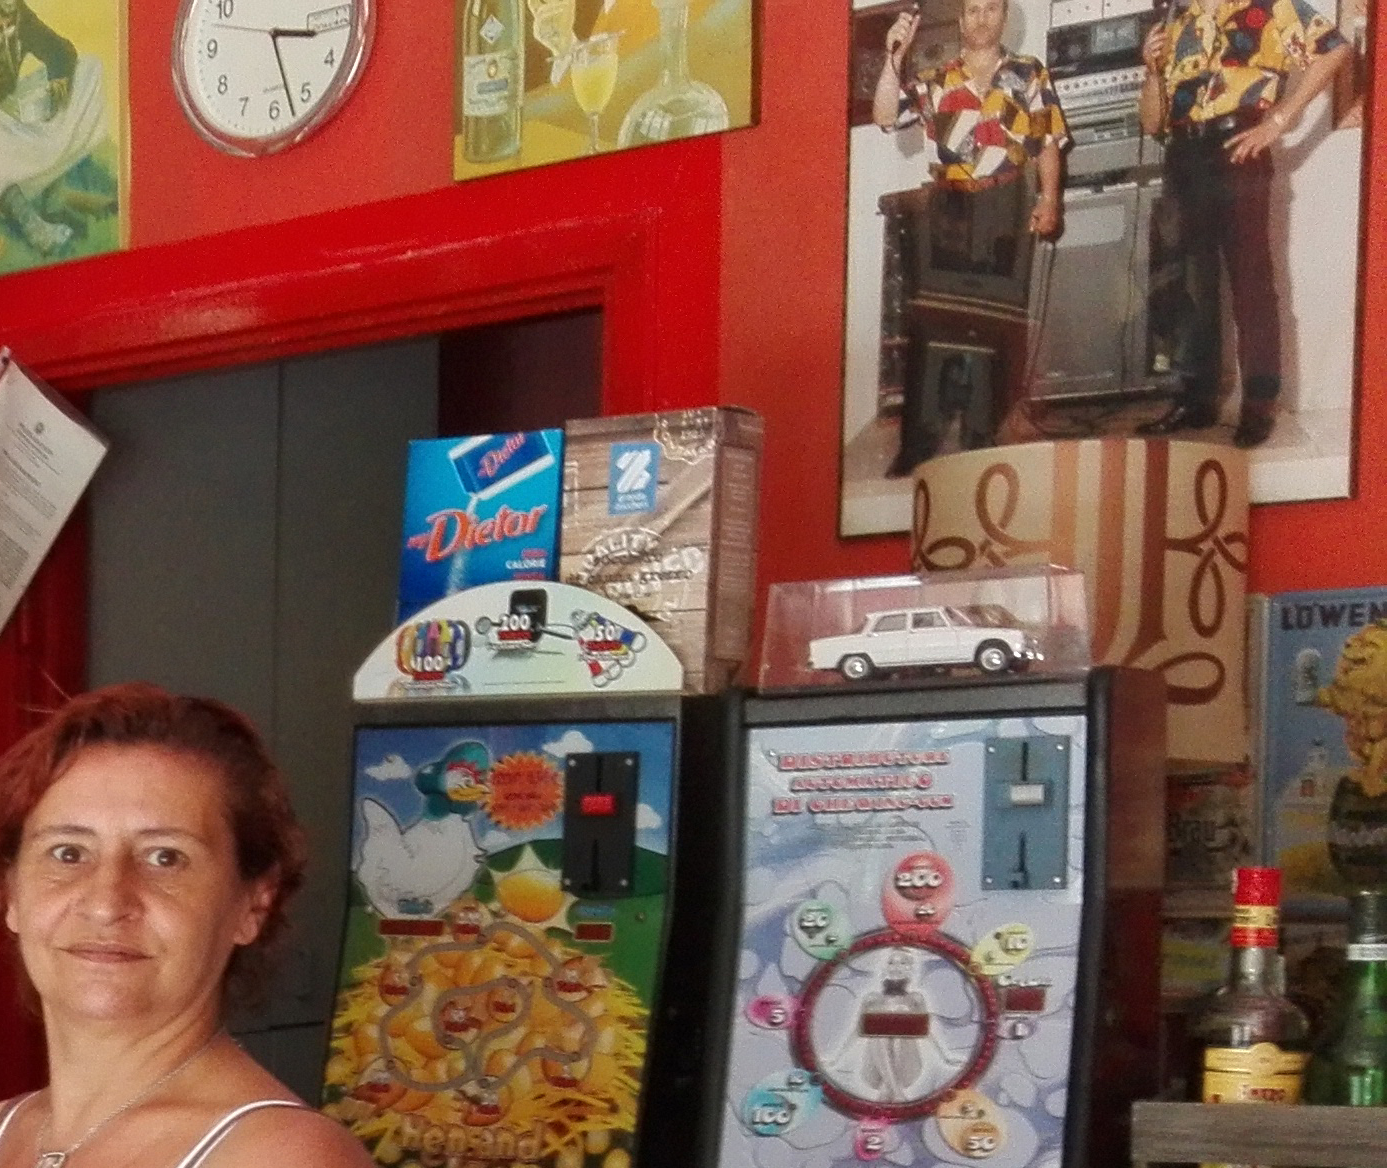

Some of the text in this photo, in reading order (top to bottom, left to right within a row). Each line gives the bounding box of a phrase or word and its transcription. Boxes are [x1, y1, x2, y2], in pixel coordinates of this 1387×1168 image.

[207, 38, 218, 59] 9
[324, 48, 335, 67] 4
[217, 74, 228, 95] 8
[300, 82, 312, 103] 5
[238, 96, 249, 116] 7
[268, 100, 280, 120] 6
[499, 614, 531, 632] 200
